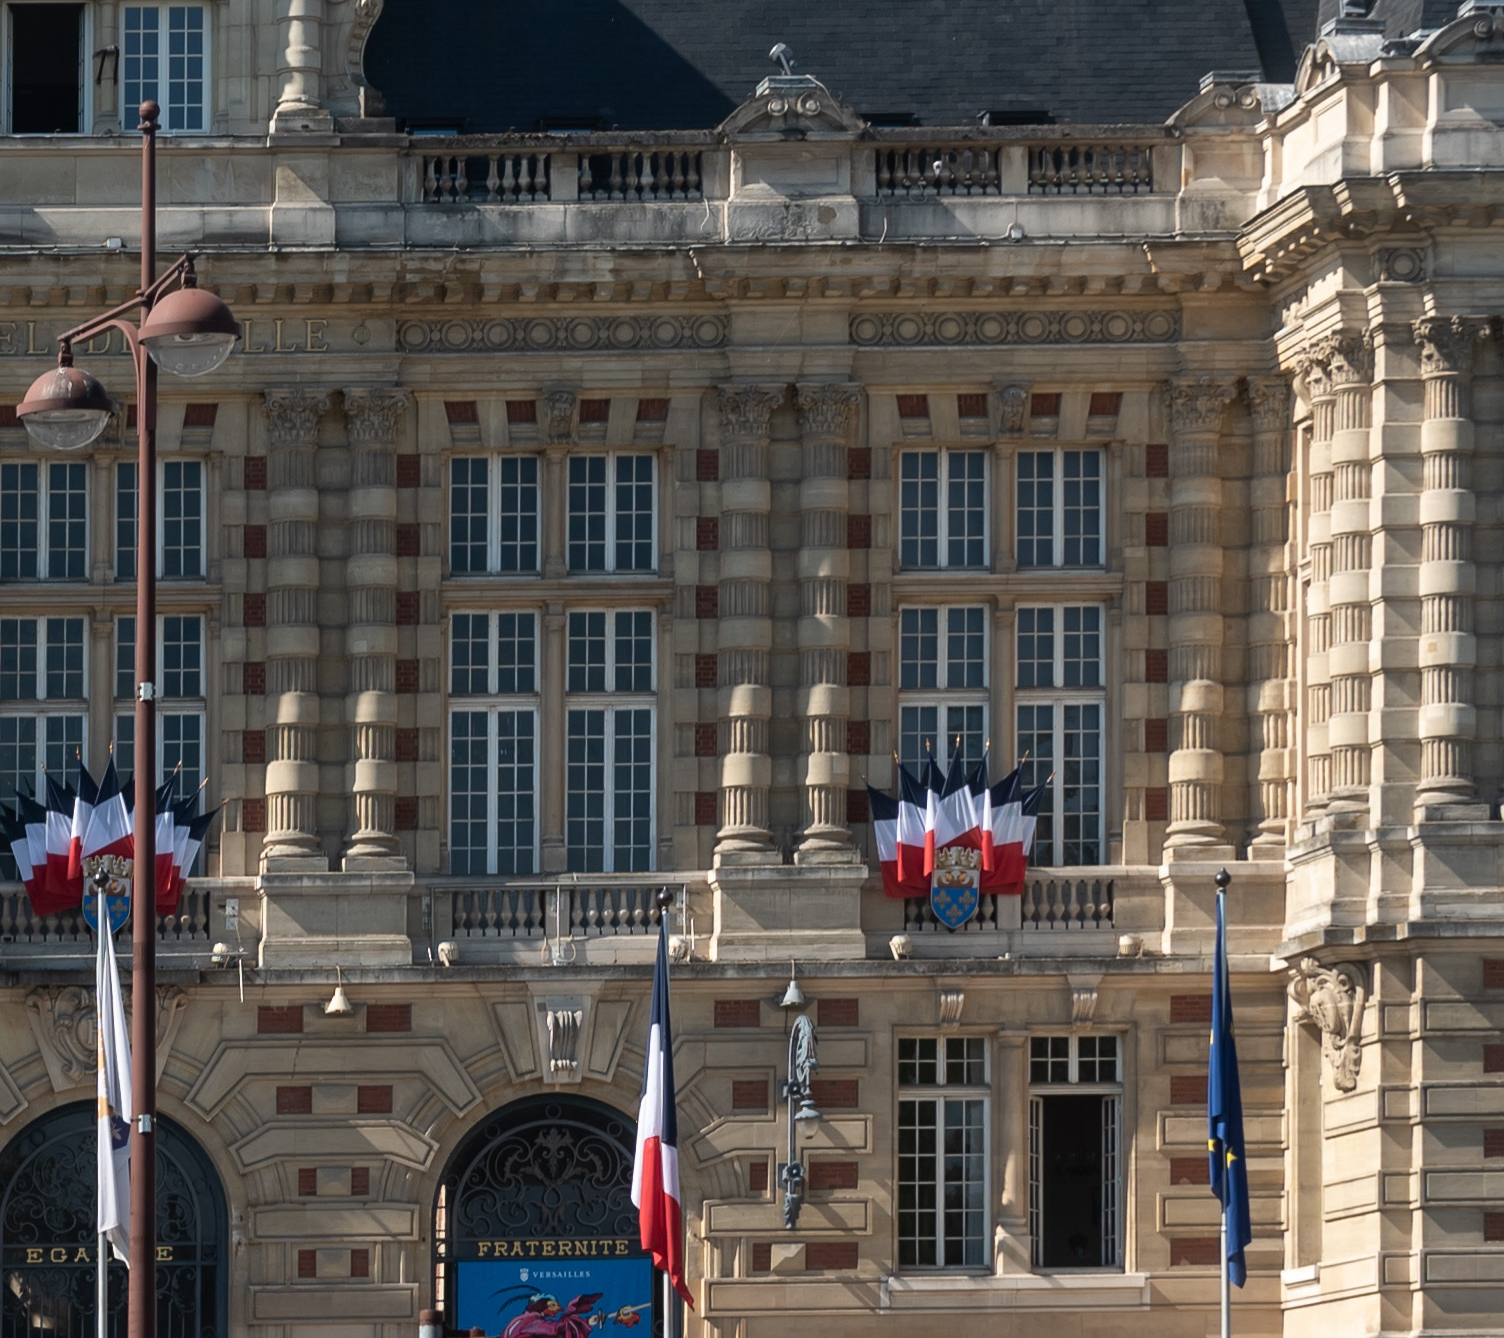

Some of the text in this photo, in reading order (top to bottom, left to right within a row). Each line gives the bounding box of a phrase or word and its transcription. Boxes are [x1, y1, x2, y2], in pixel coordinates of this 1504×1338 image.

[86, 328, 134, 354] D
[26, 1246, 173, 1263] EGAE
[478, 1240, 629, 1256] FRATERNITE
